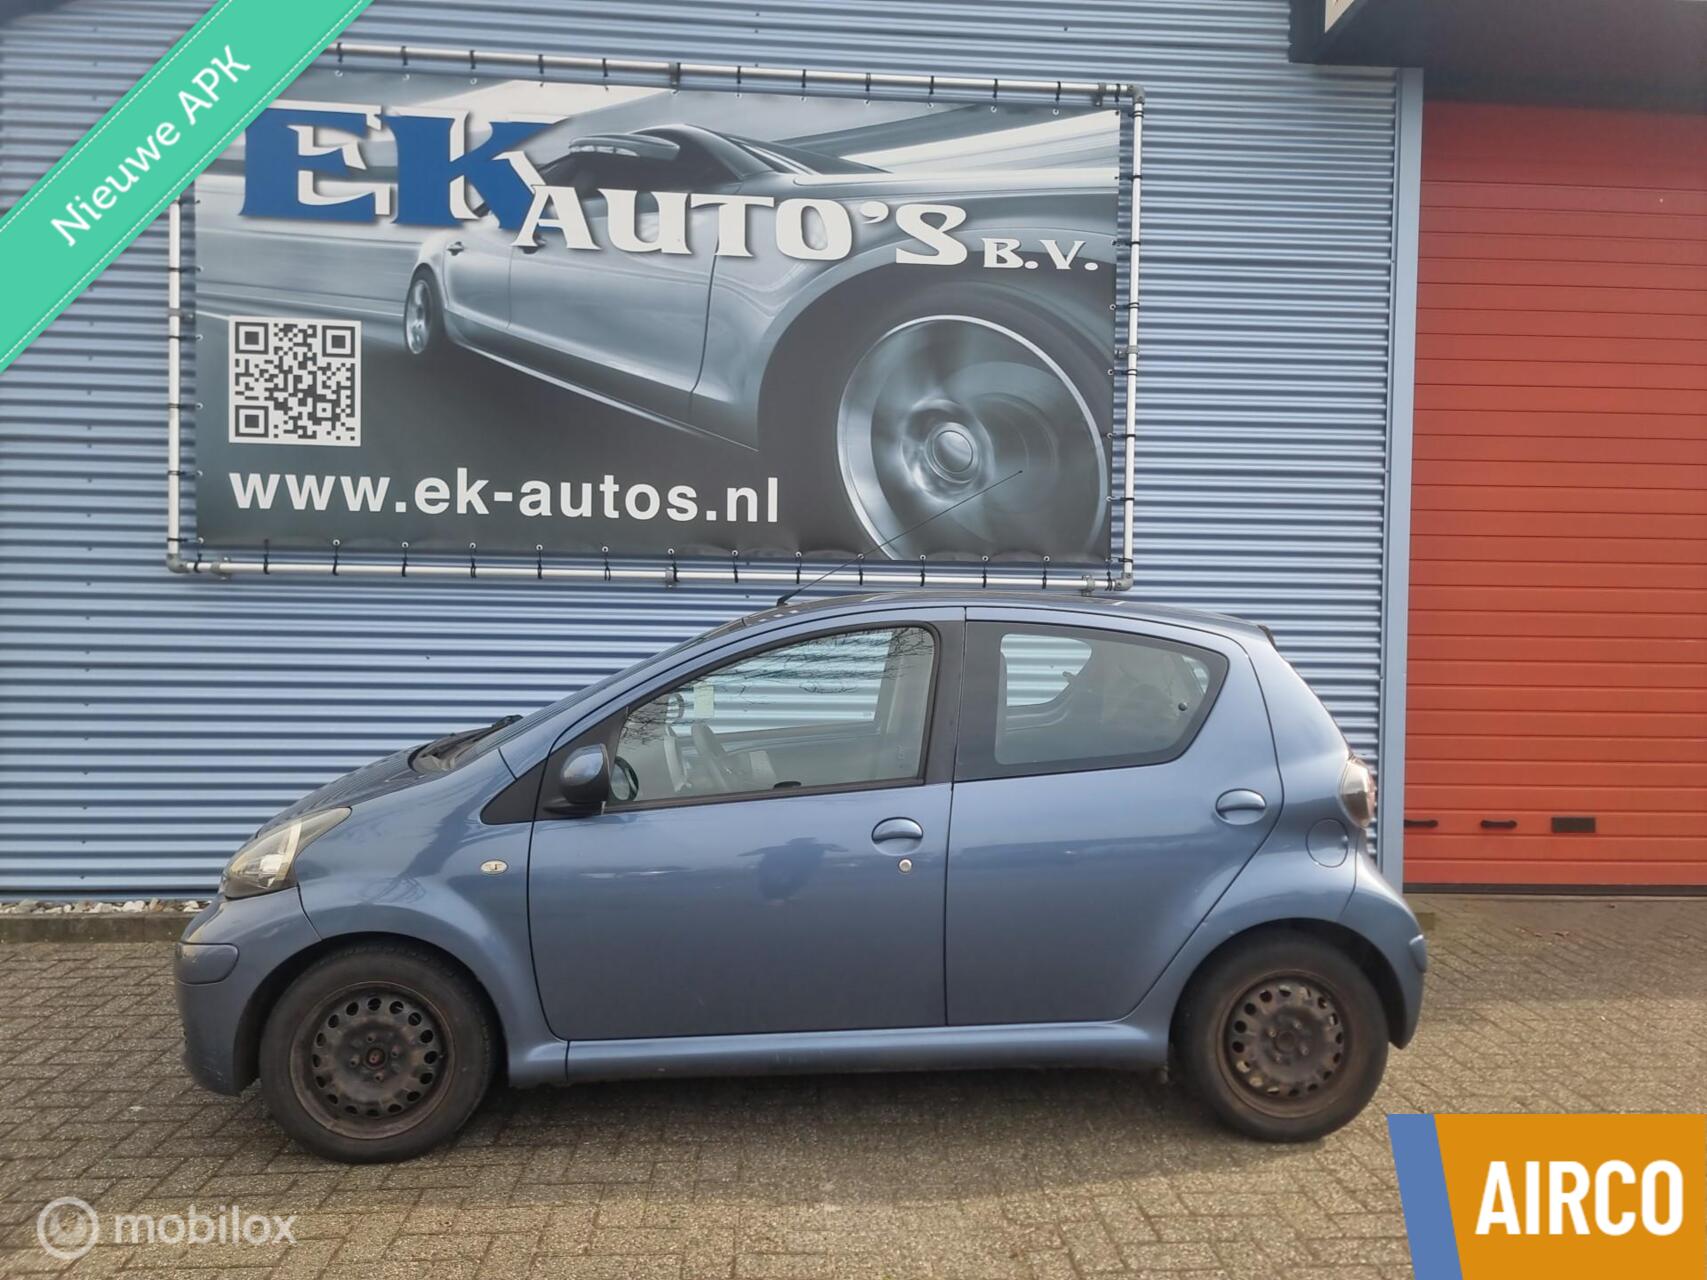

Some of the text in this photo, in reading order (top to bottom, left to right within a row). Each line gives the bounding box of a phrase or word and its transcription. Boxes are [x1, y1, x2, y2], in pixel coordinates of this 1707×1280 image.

[239, 102, 568, 229] EK
[982, 237, 1099, 271] B.V.
[229, 467, 780, 524] www.ek-autos.nl
